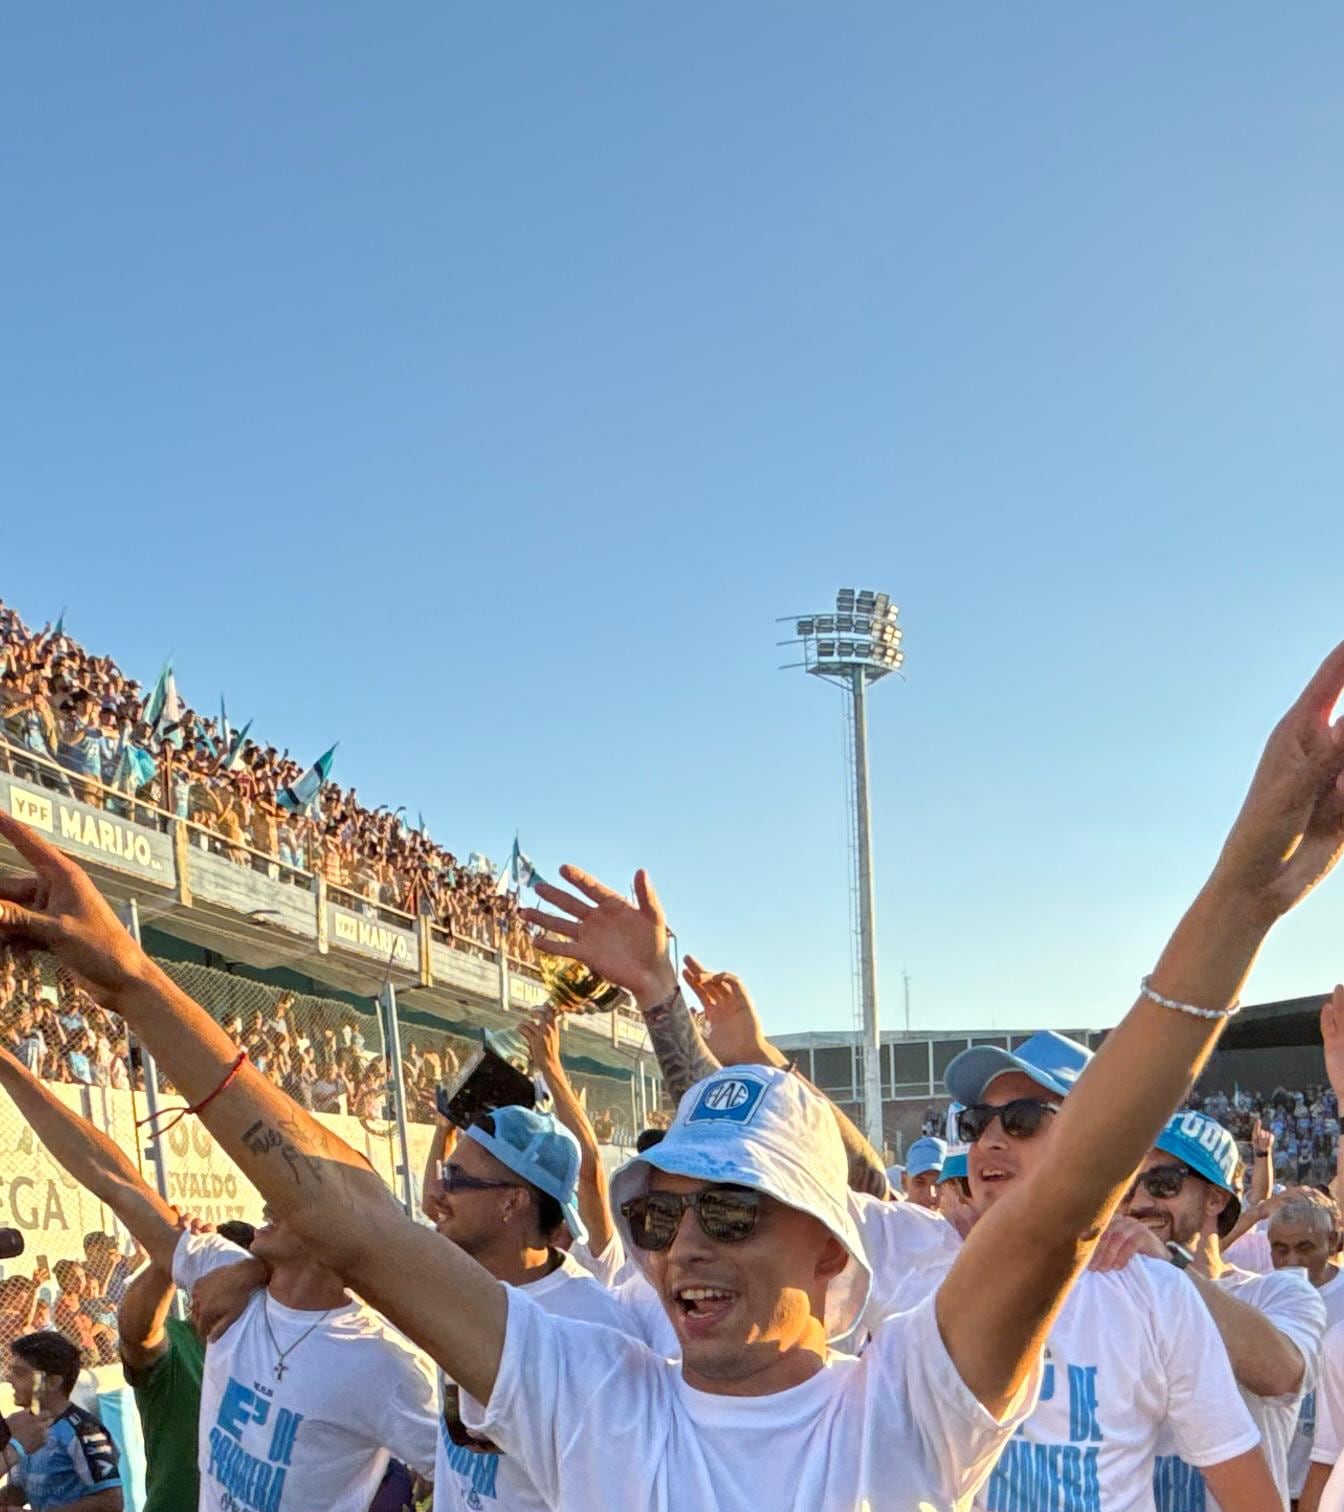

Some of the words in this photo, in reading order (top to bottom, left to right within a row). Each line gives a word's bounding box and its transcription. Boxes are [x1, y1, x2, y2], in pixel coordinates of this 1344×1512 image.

[15, 797, 48, 821] YPF
[59, 805, 152, 866] MARIJO
[1067, 1363, 1104, 1443] DE
